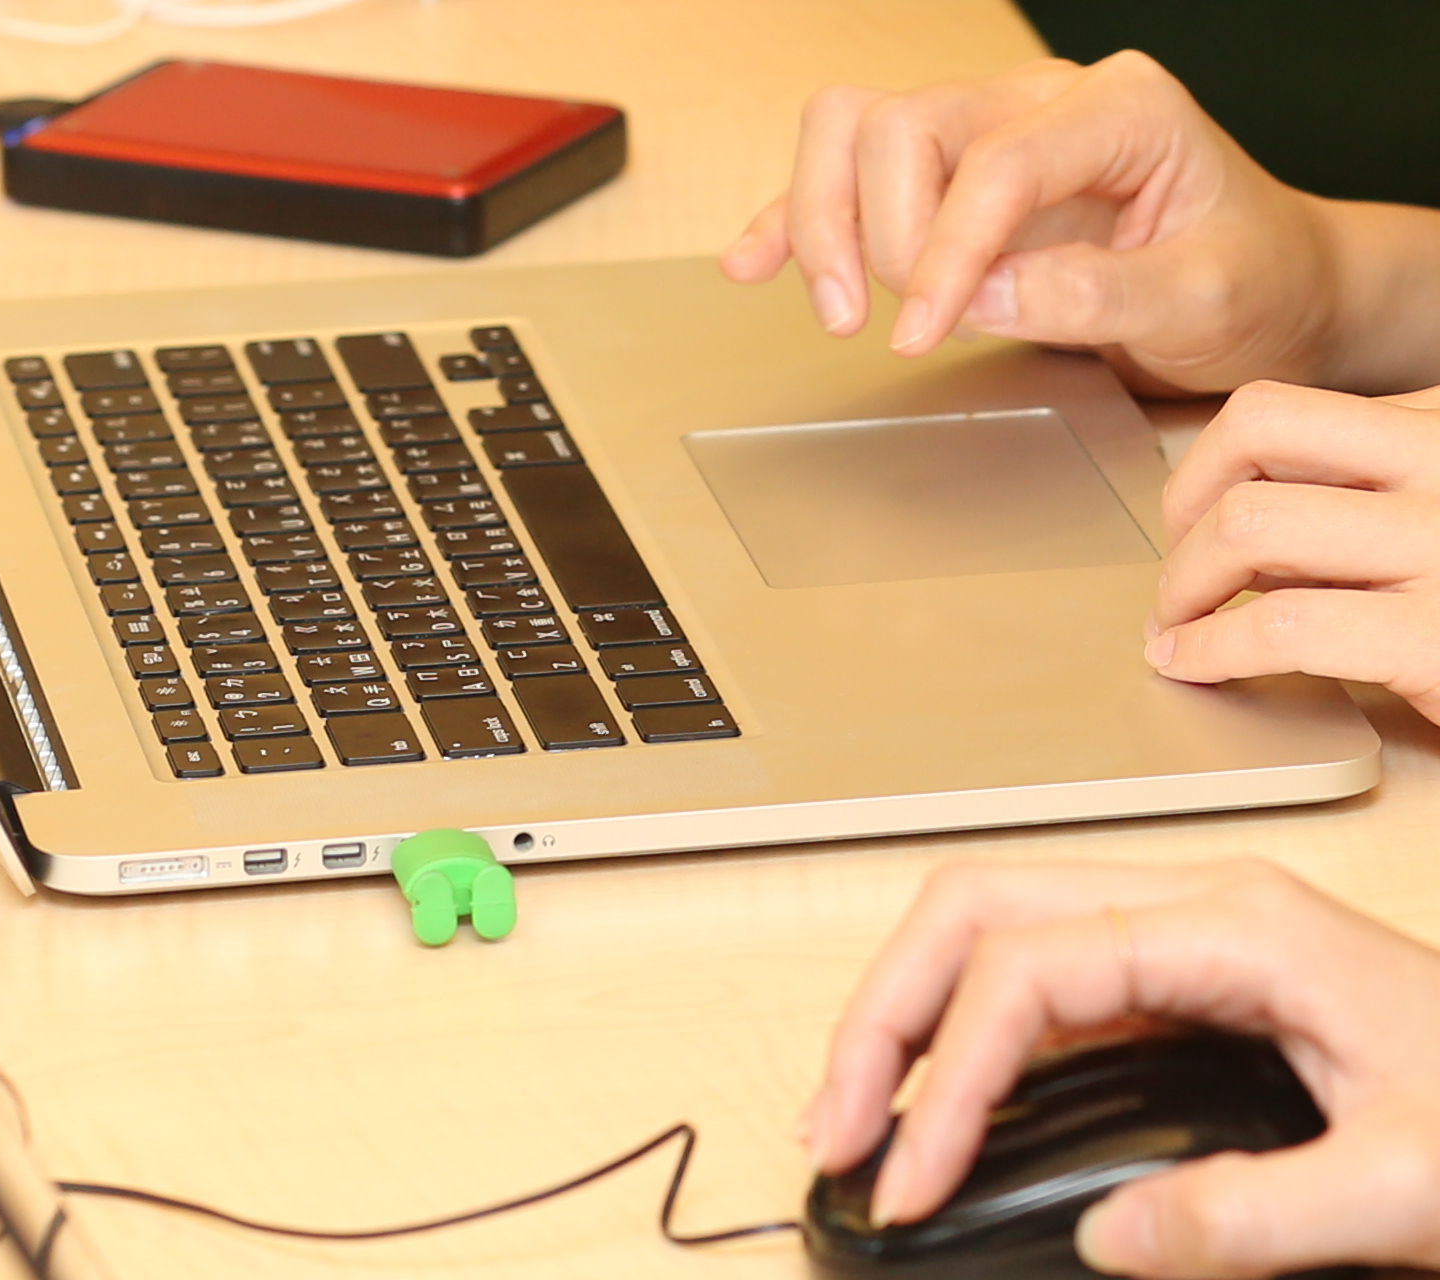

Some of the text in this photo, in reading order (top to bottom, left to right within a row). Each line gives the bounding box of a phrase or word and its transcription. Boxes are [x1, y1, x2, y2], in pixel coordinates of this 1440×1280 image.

[473, 511, 498, 523] N
[385, 532, 410, 543] H
[488, 541, 515, 551] B
[399, 561, 425, 572] G
[201, 569, 226, 577] 6
[503, 570, 529, 580] V
[306, 577, 333, 586] T
[214, 597, 240, 607] 5
[414, 593, 441, 602] F
[519, 599, 545, 609] C
[321, 605, 348, 616] R
[430, 621, 456, 631] D
[642, 607, 673, 637] command
[228, 628, 252, 636] 4
[534, 628, 561, 639] X
[335, 636, 362, 645] E
[445, 651, 471, 661] S
[669, 647, 693, 667] option
[241, 659, 267, 668] 3
[550, 659, 578, 670] Z
[348, 664, 377, 677] W
[460, 680, 487, 690] A
[682, 677, 708, 698] control
[255, 689, 281, 699] 2
[365, 696, 392, 707] Q
[706, 718, 725, 728] fn
[481, 715, 511, 743] caps lock
[587, 721, 610, 736] shift
[389, 739, 409, 752] tab
[185, 749, 202, 762] esc
